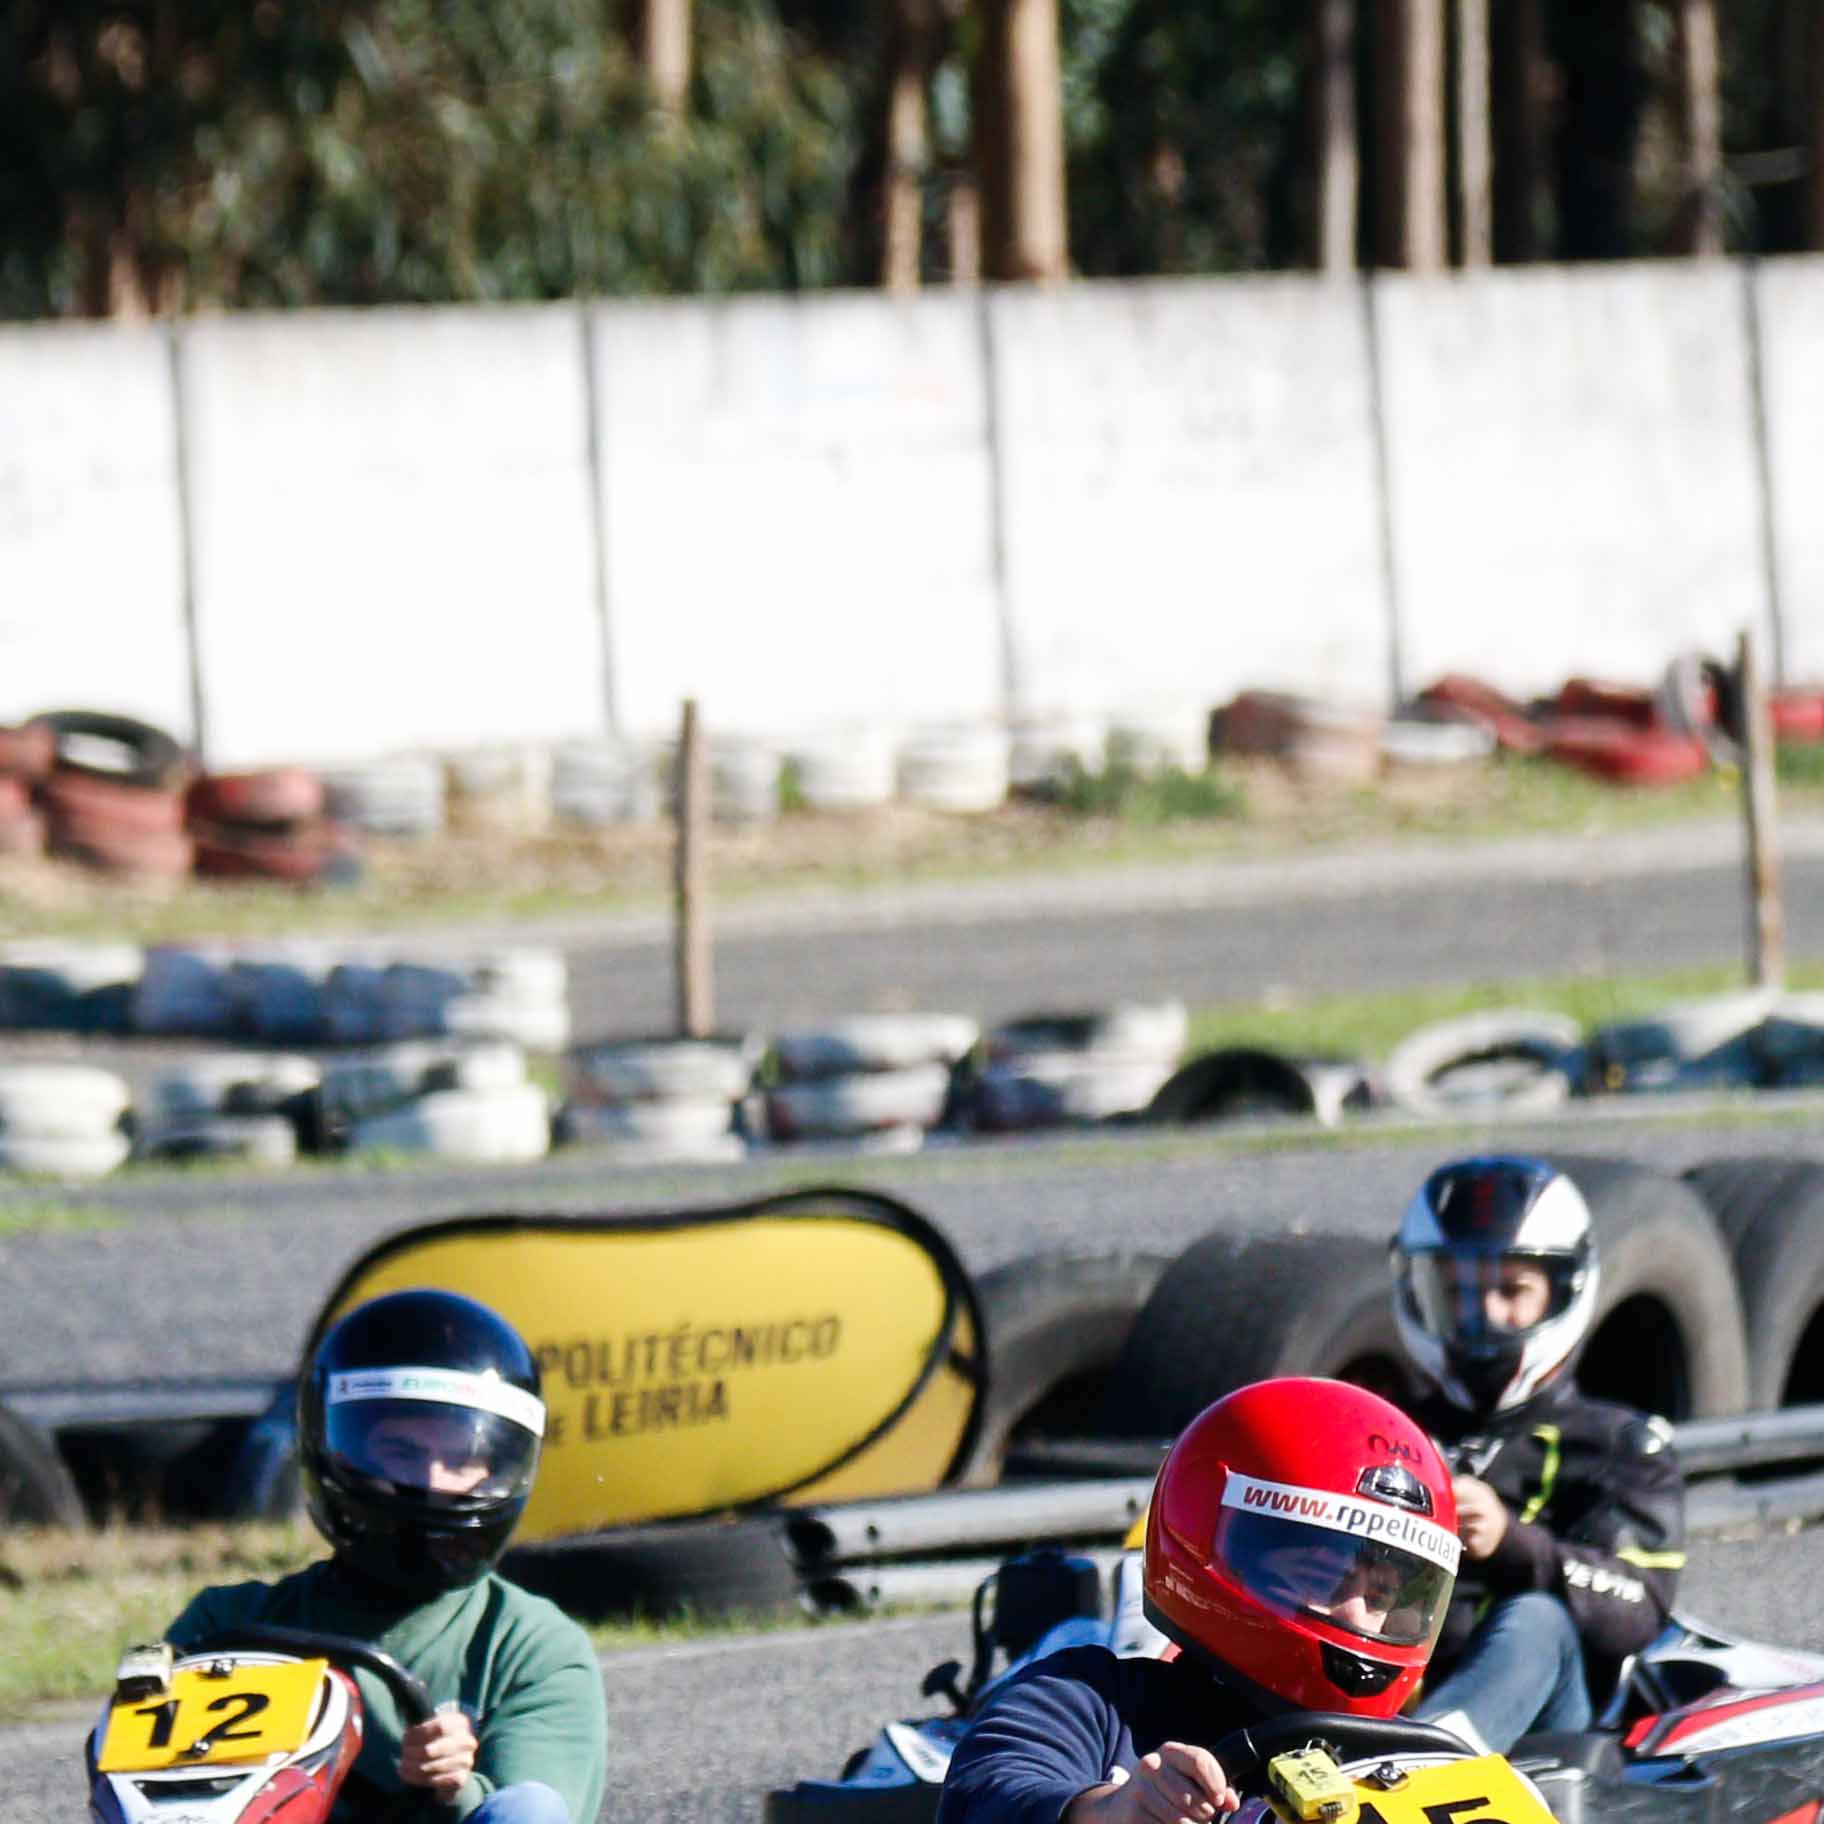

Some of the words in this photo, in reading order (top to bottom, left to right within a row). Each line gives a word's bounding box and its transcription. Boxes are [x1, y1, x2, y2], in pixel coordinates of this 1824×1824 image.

[536, 1314, 841, 1388] POLITÉCNICO
[583, 1381, 729, 1442] LEIRIA
[134, 1693, 270, 1749] 12
